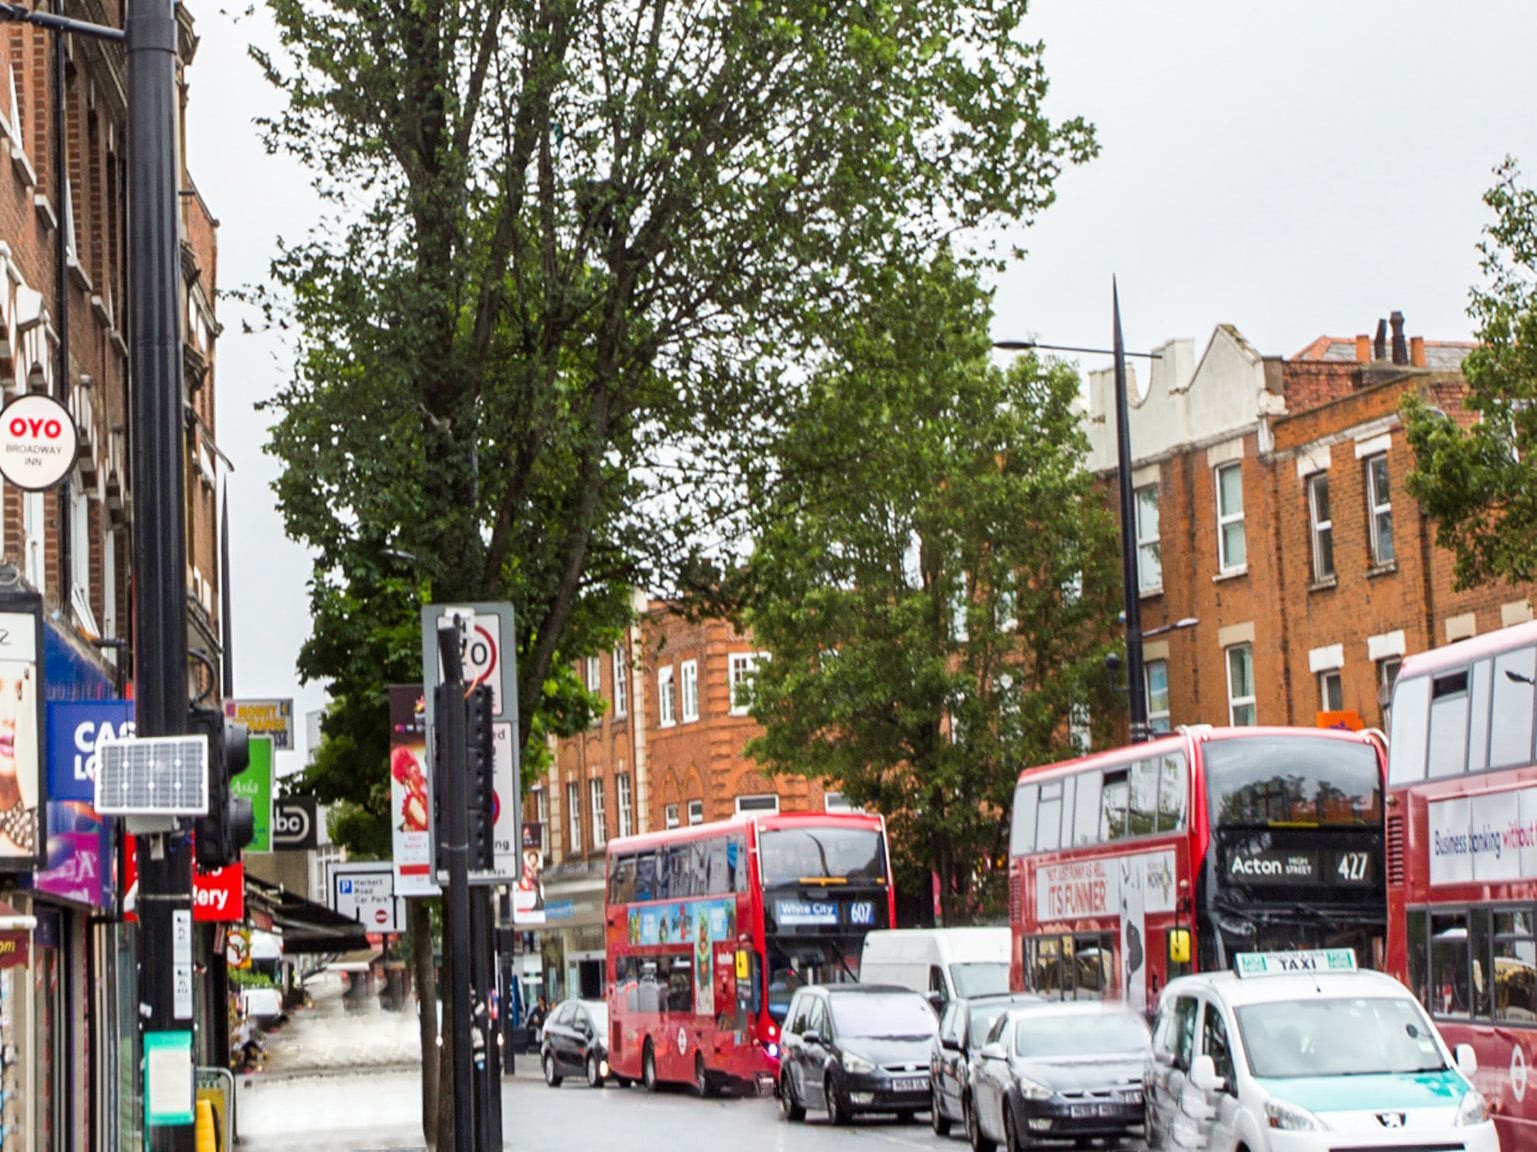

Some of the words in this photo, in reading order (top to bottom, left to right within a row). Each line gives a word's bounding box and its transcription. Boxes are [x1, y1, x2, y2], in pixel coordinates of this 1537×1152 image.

[9, 417, 62, 439] OYO
[6, 444, 62, 455] BROADWAY
[25, 458, 42, 466] INN
[272, 805, 301, 832] bc
[1434, 829, 1467, 856] Business
[1231, 855, 1282, 875] Acton
[1338, 852, 1368, 880] 427
[1286, 865, 1312, 875] STREET
[781, 902, 811, 914] White
[812, 902, 833, 915] City
[851, 902, 872, 923] 607
[1279, 958, 1317, 970] TAXI
